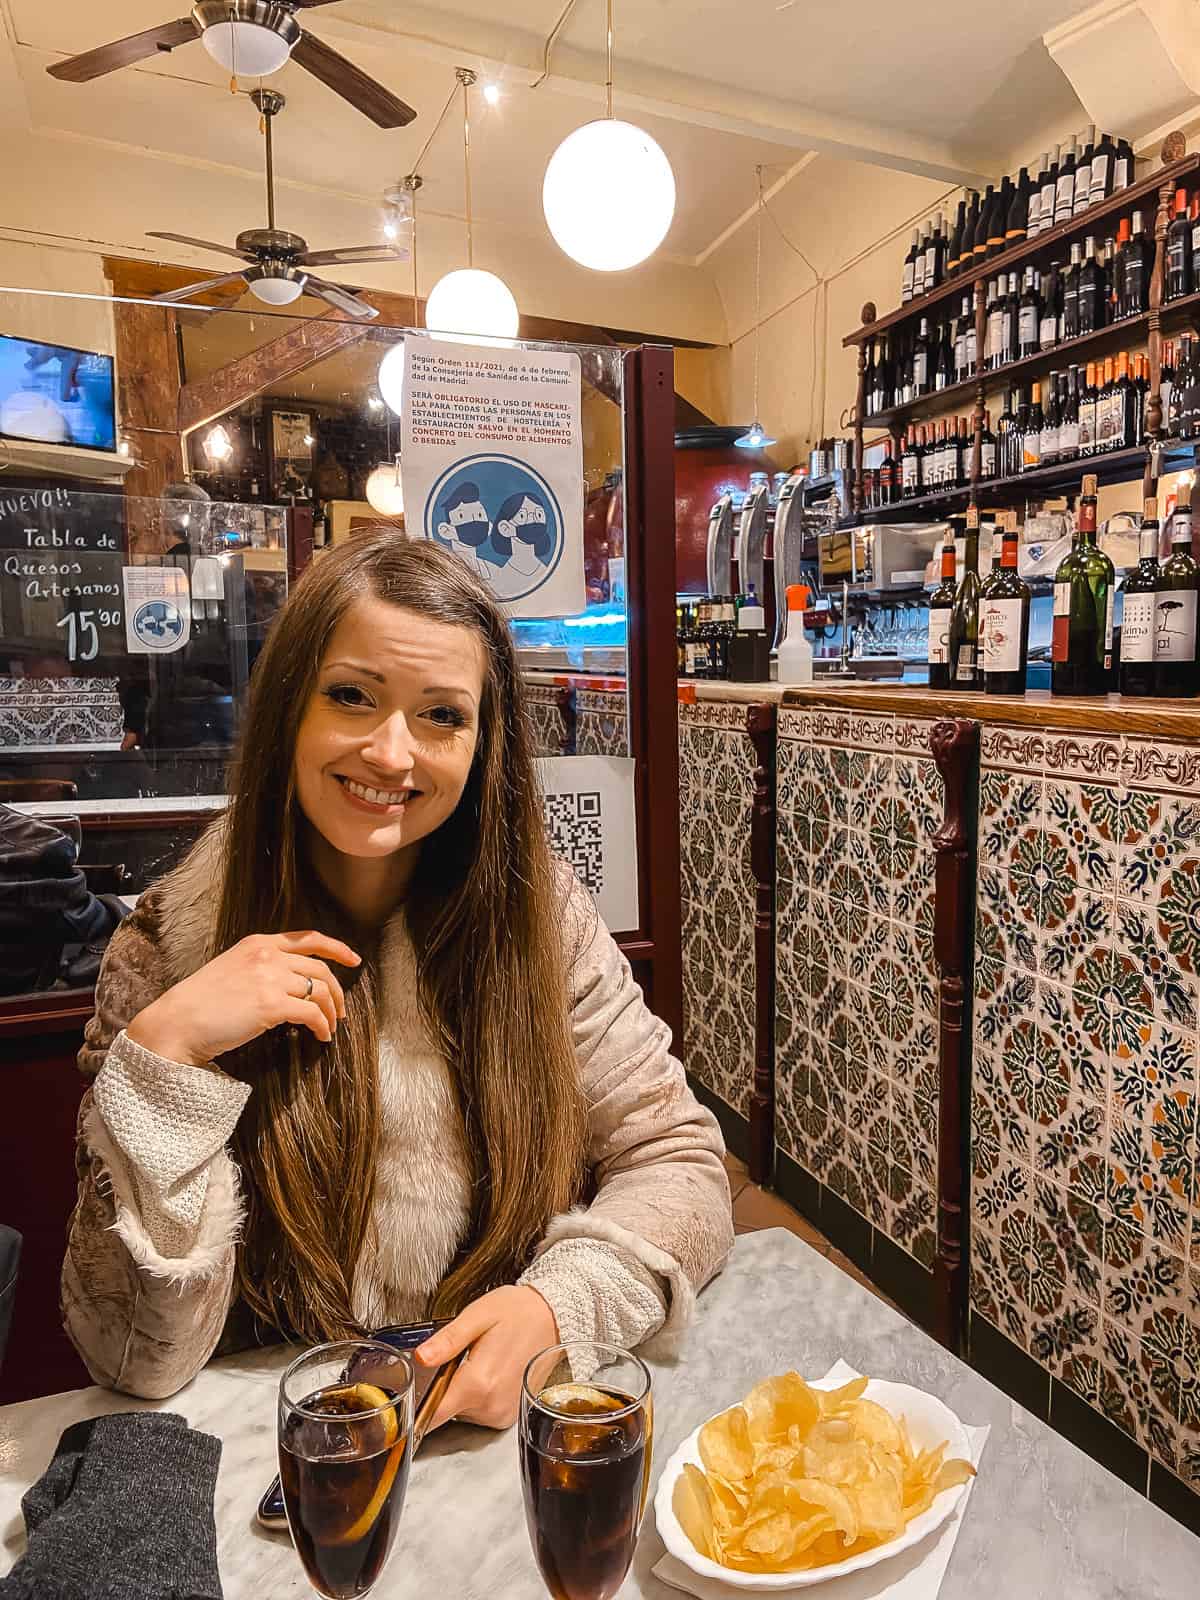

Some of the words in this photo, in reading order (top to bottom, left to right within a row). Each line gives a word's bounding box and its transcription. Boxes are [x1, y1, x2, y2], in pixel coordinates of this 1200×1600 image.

[411, 363, 421, 371] de
[432, 366, 473, 377] Consejería
[487, 371, 518, 381] Sanidad
[540, 376, 572, 385] Comuni-
[411, 373, 425, 381] dad
[438, 358, 462, 367] Orden
[465, 361, 504, 373] 112/2021,
[541, 367, 571, 377] febrero,
[411, 399, 427, 408] LLA
[429, 402, 451, 410] PARA
[454, 404, 480, 413] TODAS
[483, 406, 498, 414] LAS
[500, 407, 541, 417] PERSONAS
[556, 412, 571, 420] LOS
[434, 393, 490, 405] OBLIGATORIO
[492, 398, 501, 406] EL
[503, 399, 520, 407] USO
[521, 400, 532, 408] DE
[534, 401, 570, 411] MASCARI-
[411, 409, 491, 422] ESTABLECIMIENTOS
[497, 416, 508, 424] DE
[513, 417, 561, 427] HOSTELERÍA
[566, 421, 571, 429] Y
[412, 418, 474, 430] RESTAURACIÓN
[477, 423, 504, 432] SALVO
[507, 425, 518, 433] EN
[520, 426, 530, 434] EL
[533, 427, 571, 437] MOMENTO
[412, 427, 455, 437] CONCRETO
[457, 431, 473, 439] DEL
[474, 432, 514, 441] CONSUMO
[516, 434, 527, 442] DE
[528, 435, 572, 445] ALIMENTOS
[420, 437, 457, 446] BEBIDAS
[23, 528, 88, 547] Tabla
[96, 533, 117, 550] de
[4, 556, 82, 576] Quesos
[26, 580, 120, 598] Artesanos
